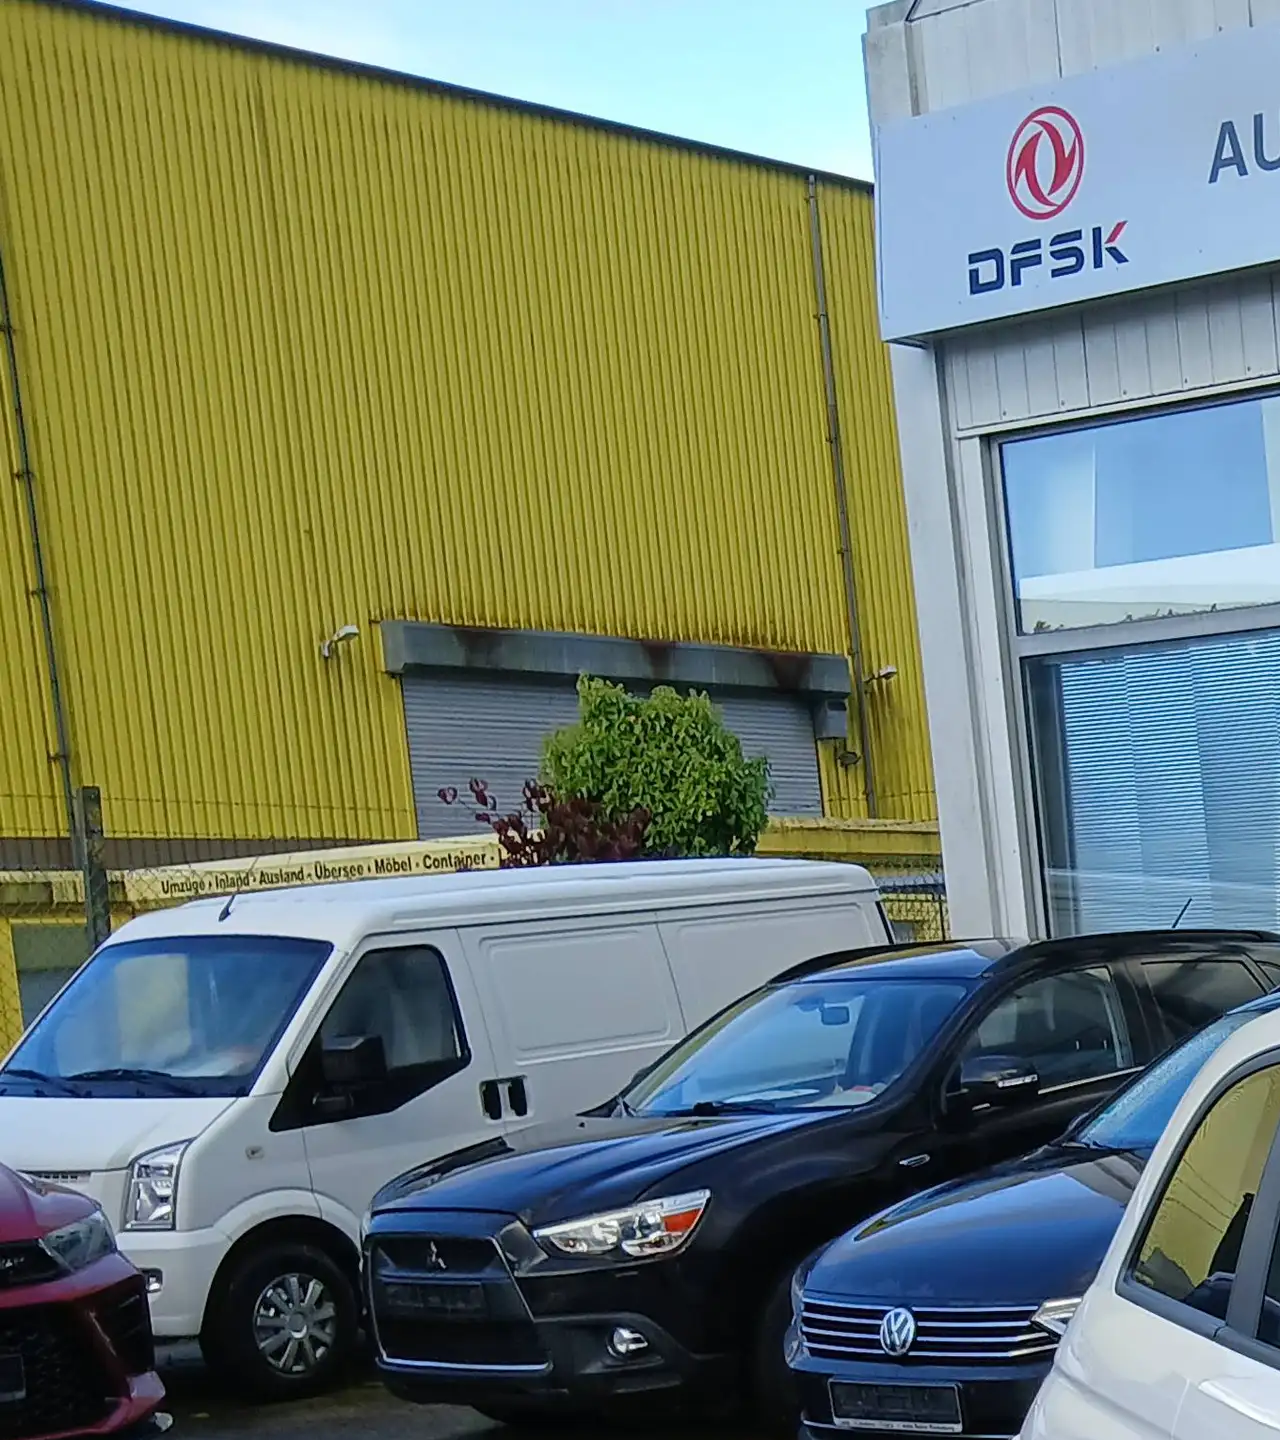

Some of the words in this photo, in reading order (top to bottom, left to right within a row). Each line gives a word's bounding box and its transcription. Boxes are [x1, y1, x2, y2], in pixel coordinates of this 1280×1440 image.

[968, 220, 1129, 295] DFSK
[259, 866, 304, 885] Ausland
[374, 856, 412, 874] Möbel
[423, 851, 486, 869] Container
